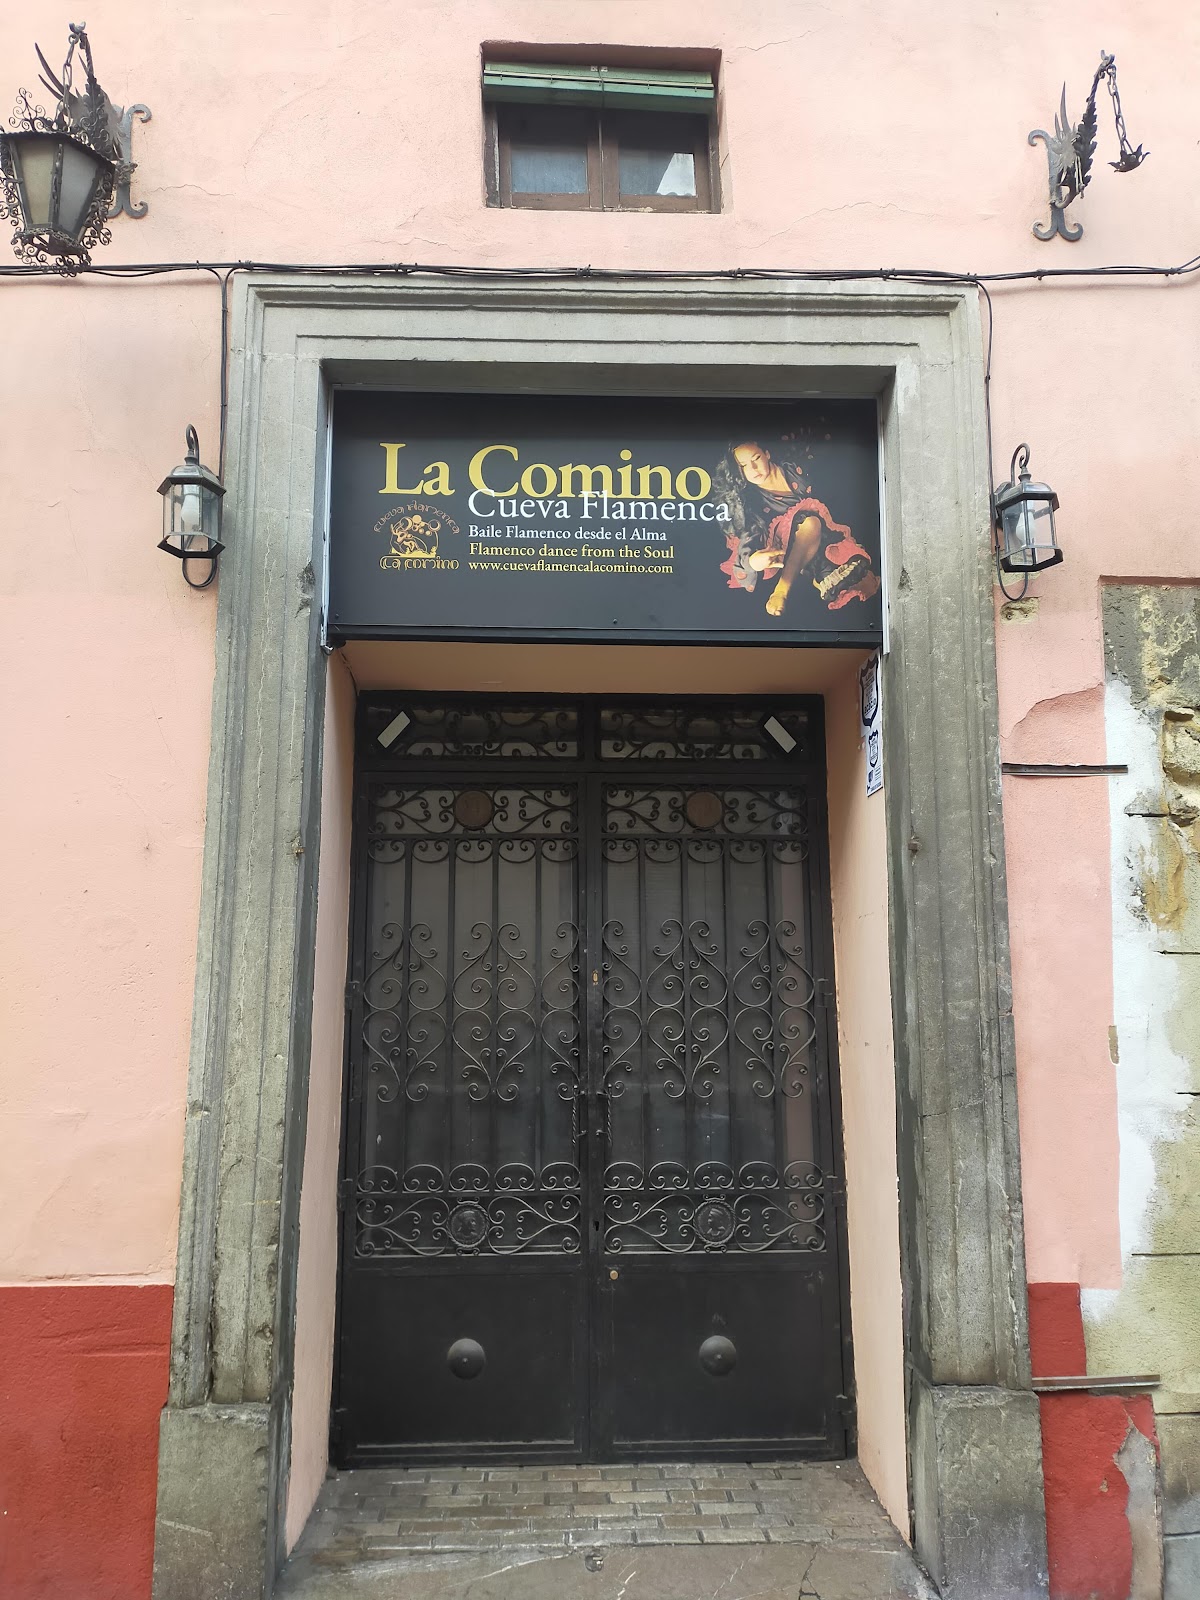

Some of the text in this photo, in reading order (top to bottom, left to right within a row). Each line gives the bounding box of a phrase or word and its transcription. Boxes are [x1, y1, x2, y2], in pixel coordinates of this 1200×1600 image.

[379, 442, 712, 501] La Comino
[468, 488, 732, 522] Cueva Flamenca
[468, 524, 668, 541] Baile Flamenco desde el Alma
[469, 542, 675, 559] Flamenco dance from the Soul
[468, 560, 674, 574] www.cuevaflamencalacomino.com
